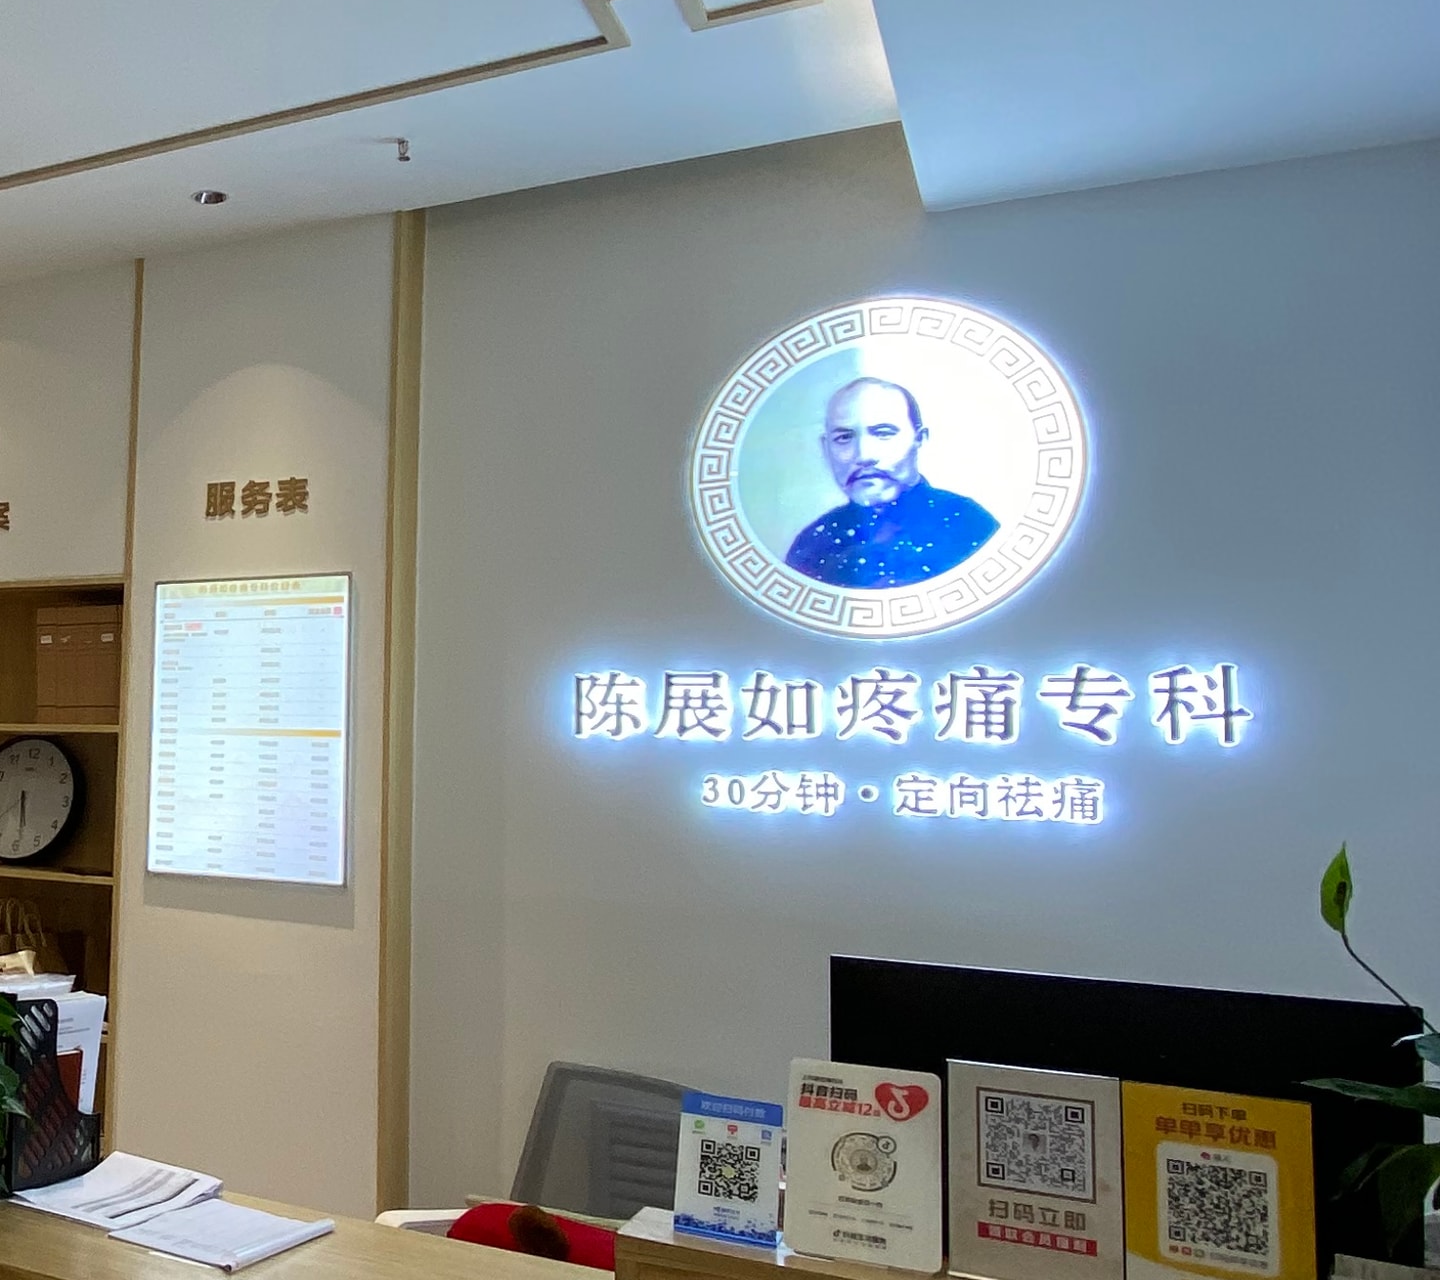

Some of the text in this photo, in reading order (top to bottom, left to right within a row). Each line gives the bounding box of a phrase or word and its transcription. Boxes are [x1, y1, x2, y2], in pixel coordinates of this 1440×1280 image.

[206, 477, 310, 518] 服务表
[571, 664, 1253, 746] 陈展如疼痛专科
[29, 748, 41, 760] 12
[59, 773, 68, 784] 2
[62, 796, 70, 808] 3
[33, 835, 41, 847] 5
[800, 1082, 858, 1101] 抖音扫码
[988, 1198, 1086, 1231] 扫码立即
